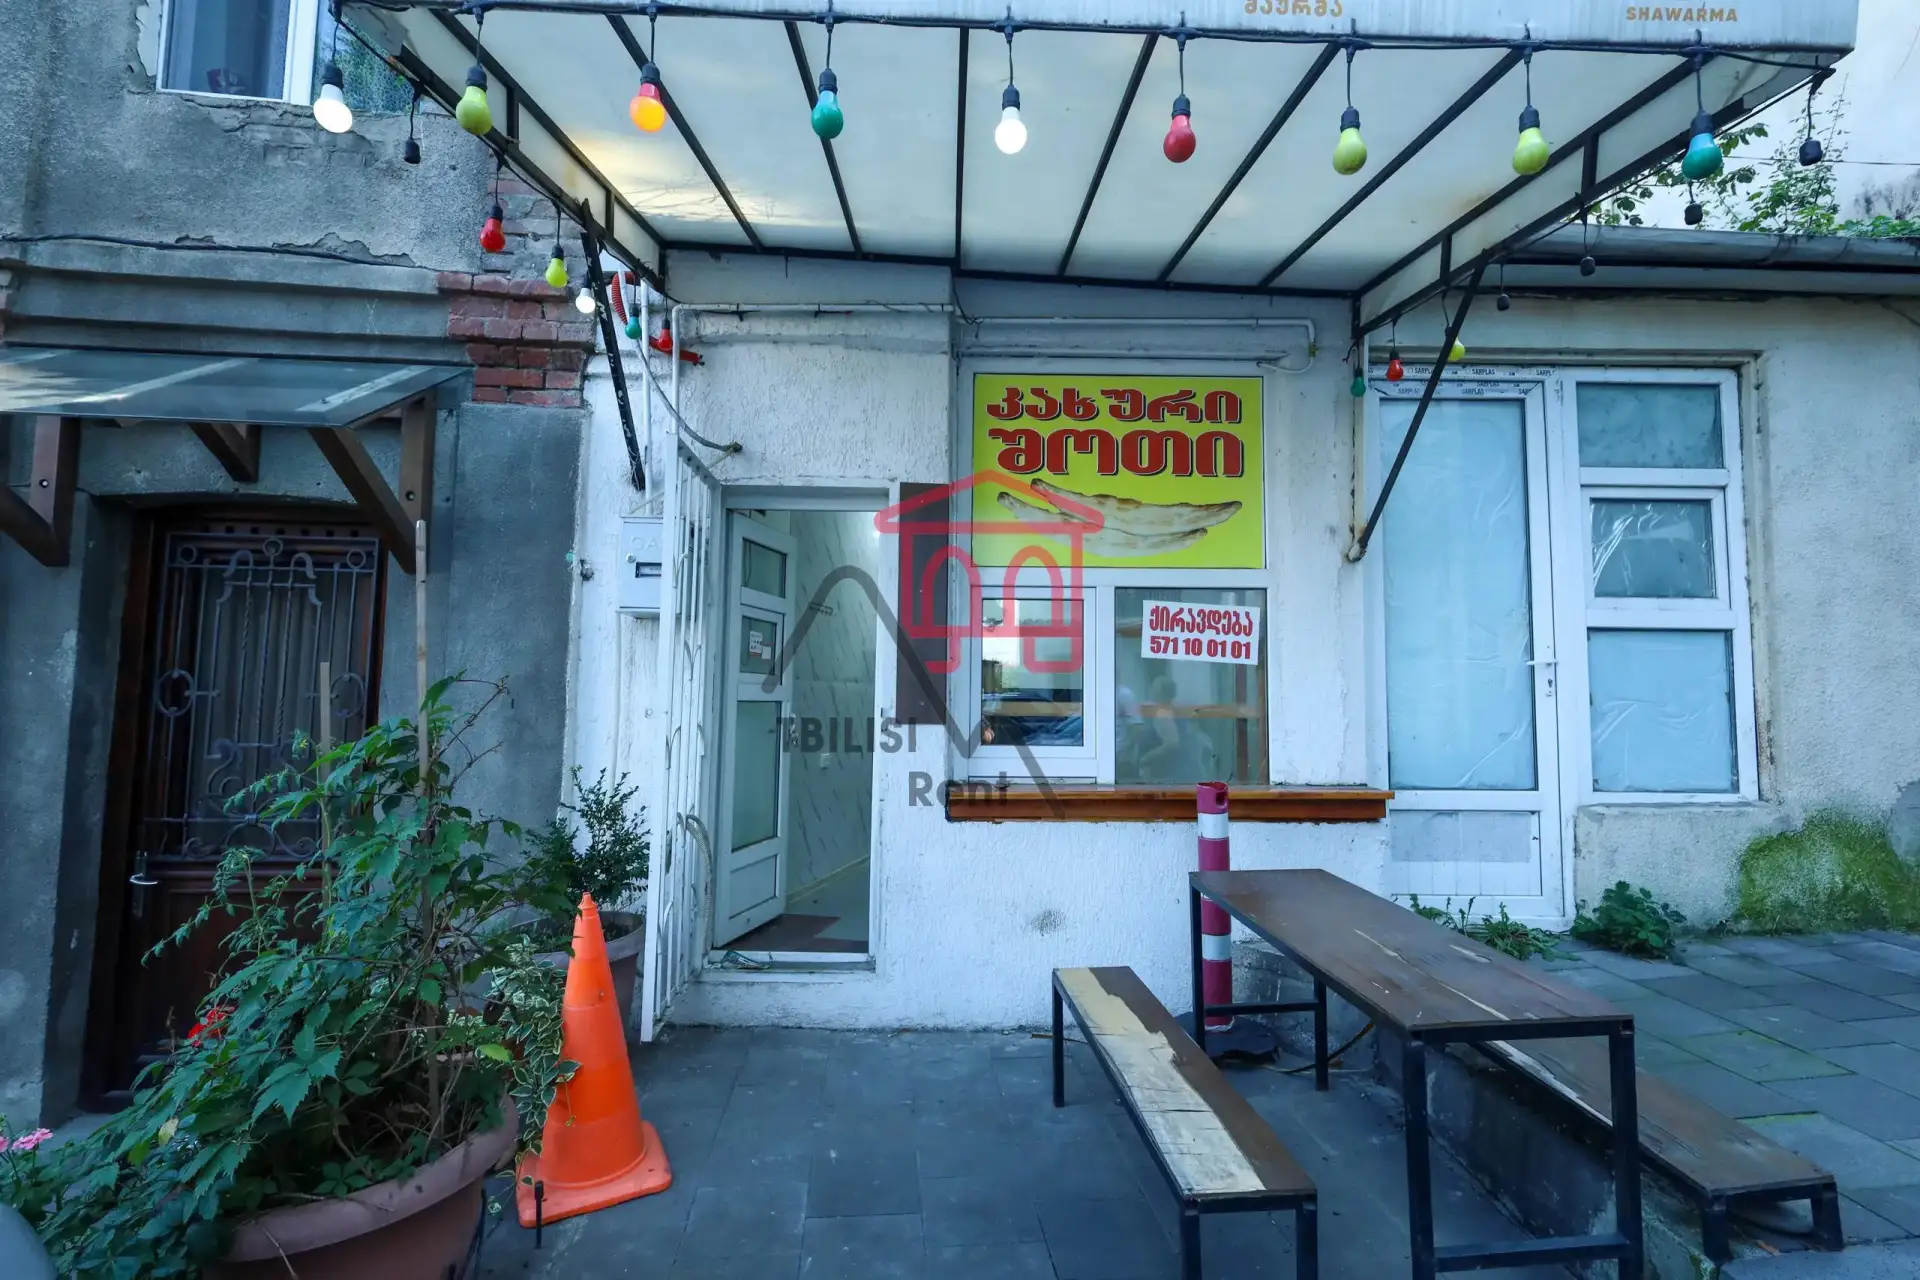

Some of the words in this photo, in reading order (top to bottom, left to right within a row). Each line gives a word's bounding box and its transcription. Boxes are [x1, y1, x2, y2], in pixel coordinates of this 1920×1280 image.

[1625, 6, 1738, 22] SHAWARMA
[986, 386, 1243, 423] კახური
[988, 427, 1244, 478] შოთი
[1149, 605, 1253, 637] ქირავდება
[1150, 635, 1179, 655] 571
[1183, 637, 1203, 656] 10
[1206, 639, 1227, 658] 01
[1230, 640, 1251, 660] 01
